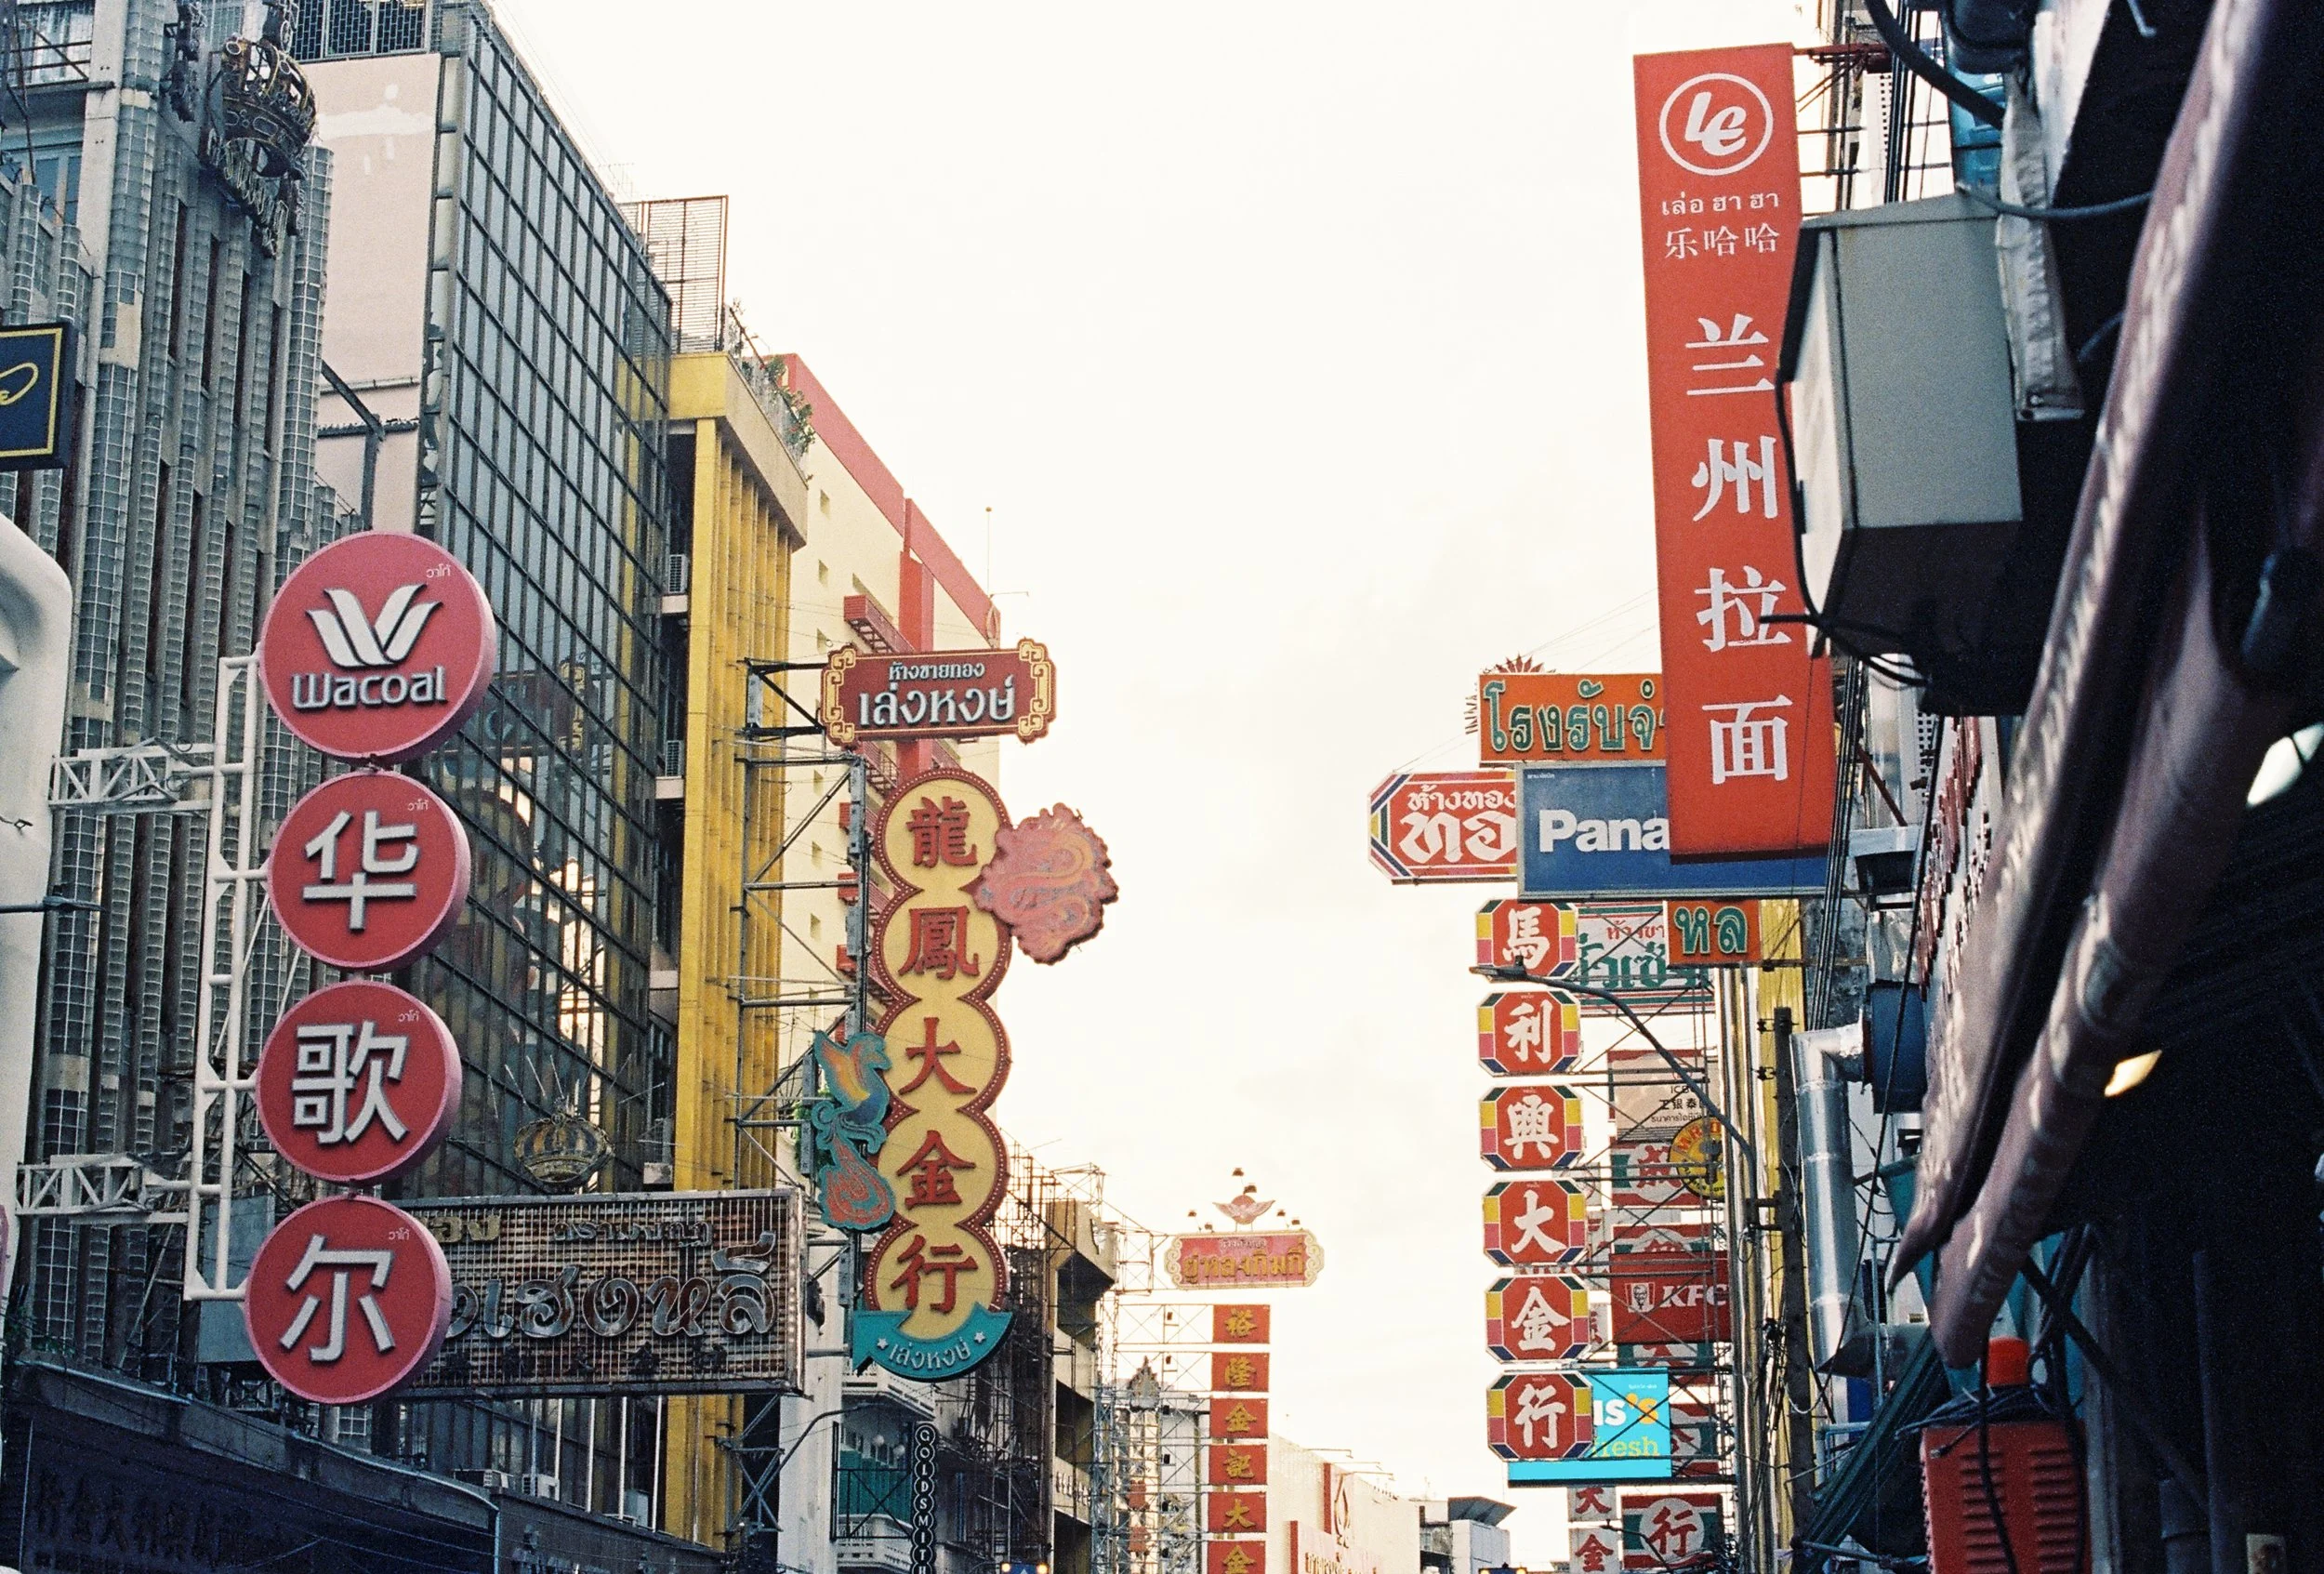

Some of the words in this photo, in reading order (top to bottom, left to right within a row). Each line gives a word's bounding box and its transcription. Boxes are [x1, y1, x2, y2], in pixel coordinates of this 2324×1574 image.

[1662, 192, 1704, 216] เล่อ
[1712, 195, 1741, 212] ฮา
[1750, 192, 1779, 209] ฮา
[1664, 222, 1780, 259] 乐哈哈
[1685, 313, 1793, 785] 兰州拉面
[291, 666, 448, 710] Wacoal
[859, 674, 1016, 727] เล่งหงษ์
[281, 811, 420, 1362] 华歌尔
[891, 796, 979, 1314] 龍鳳大金行
[1503, 906, 1570, 1449] 馬利興大金行
[1660, 1284, 1727, 1308] KFC
[918, 1429, 931, 1574] GOLDSMITH
